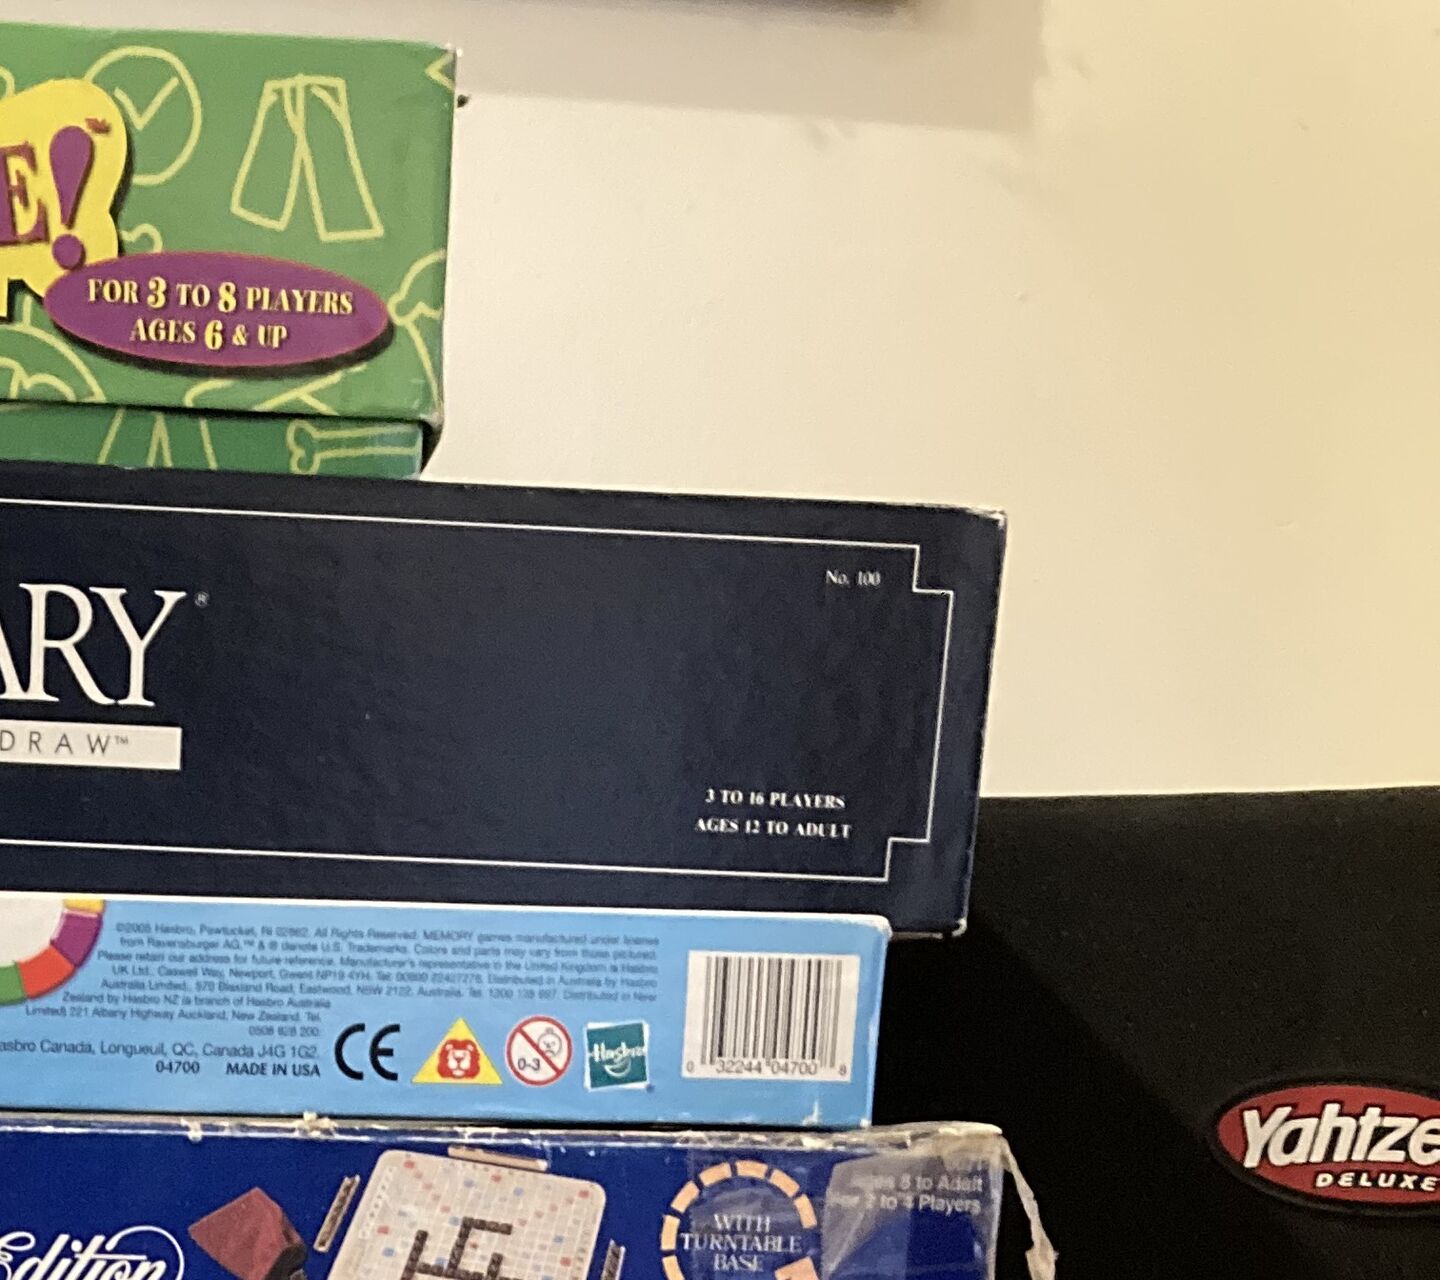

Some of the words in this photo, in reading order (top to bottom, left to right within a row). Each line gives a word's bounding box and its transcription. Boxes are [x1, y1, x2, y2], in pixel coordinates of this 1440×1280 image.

[86, 278, 141, 306] FOR
[146, 277, 167, 309] 3
[175, 282, 212, 308] TO
[217, 279, 237, 312] 8
[245, 287, 354, 316] PLAYERS
[129, 319, 196, 346] AGES
[204, 319, 224, 349] 6
[231, 325, 249, 346] &
[257, 324, 288, 349] UP
[826, 570, 849, 587] No.
[858, 571, 881, 587] 100
[721, 790, 743, 805] TO
[770, 792, 845, 809] PLAYERS
[695, 818, 739, 833] AGES
[745, 820, 760, 834] 12
[766, 820, 789, 836] TO
[795, 822, 852, 839] ADULT
[40, 1039, 95, 1055] Canada,
[202, 1043, 254, 1058] Canada
[155, 1061, 200, 1075] 04700
[226, 1062, 268, 1076] MADE
[272, 1063, 288, 1076] IN
[292, 1063, 320, 1077] USA
[517, 1058, 541, 1072] 0-3
[716, 1060, 762, 1075] 32244
[770, 1060, 818, 1076] 04700
[1315, 1172, 1437, 1192] DELUXE
[919, 1193, 981, 1217] Players
[713, 1214, 771, 1232] WITH
[681, 1232, 802, 1253] TURNTABLE
[713, 1254, 765, 1273] BASE
